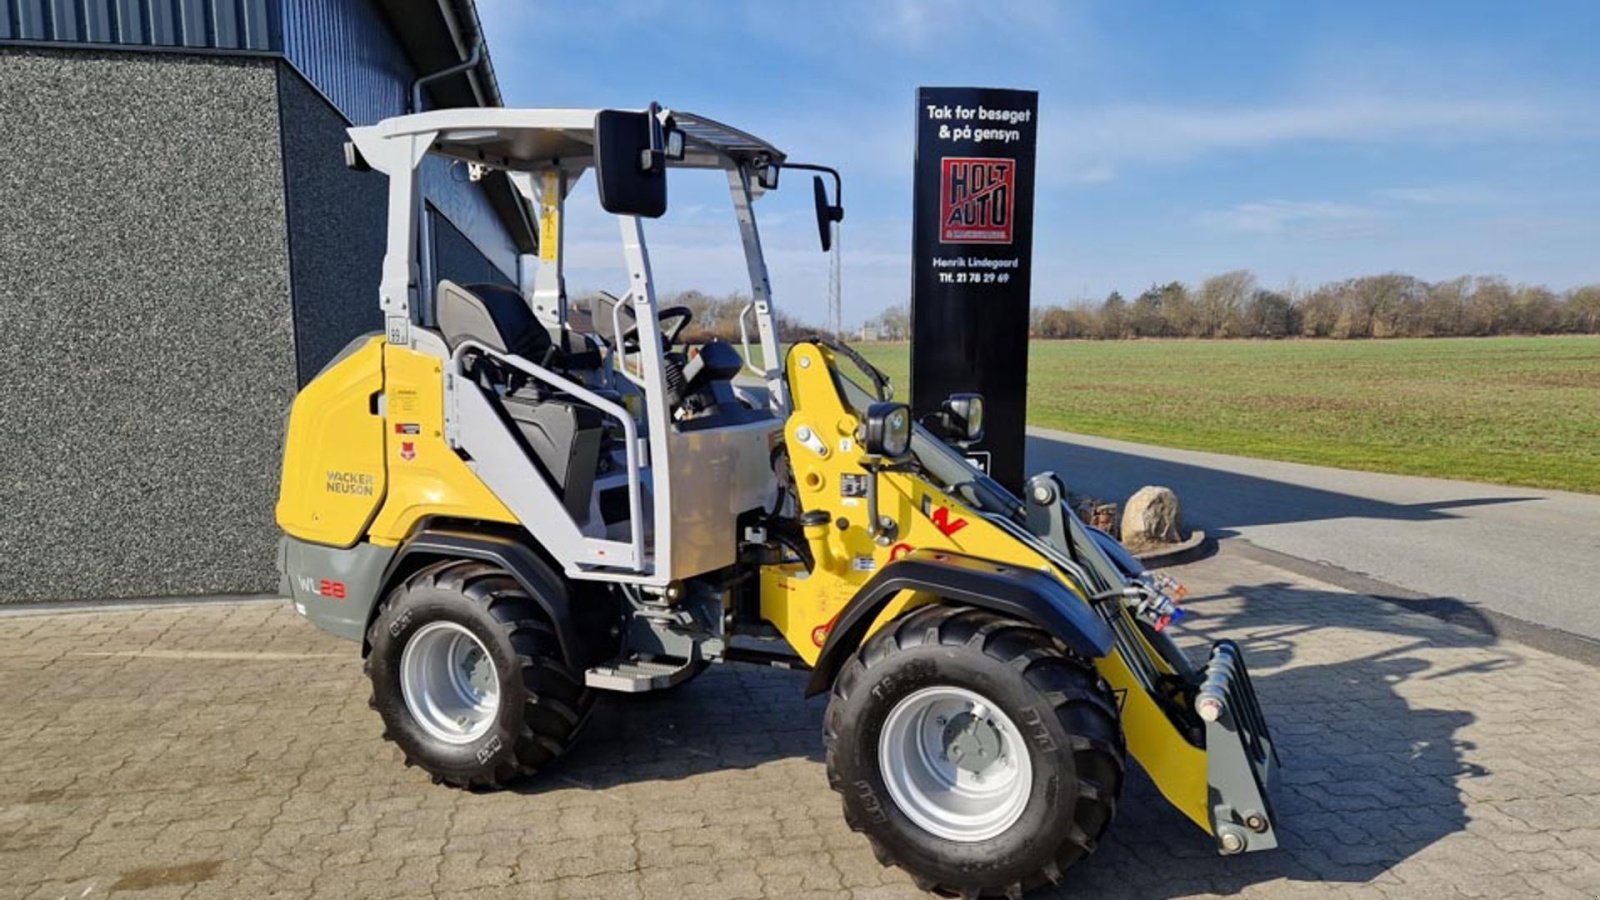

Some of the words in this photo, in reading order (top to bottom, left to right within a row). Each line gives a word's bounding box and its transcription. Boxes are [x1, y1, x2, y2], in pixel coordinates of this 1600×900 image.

[927, 105, 952, 119] Tak
[955, 105, 976, 120] for
[978, 105, 1031, 124] besøget
[939, 125, 951, 138] &
[953, 124, 971, 142] på
[974, 128, 1020, 143] gensyn
[950, 162, 1009, 206] HOLT
[946, 183, 1007, 227] AUTO
[932, 257, 965, 268] Henrik
[968, 257, 1018, 270] Lindegaard
[956, 272, 967, 283] 21
[969, 272, 981, 283] 78
[983, 272, 995, 283] 29
[997, 272, 1010, 283] 69
[327, 471, 374, 484] WACKER
[327, 482, 374, 496] NEUSON
